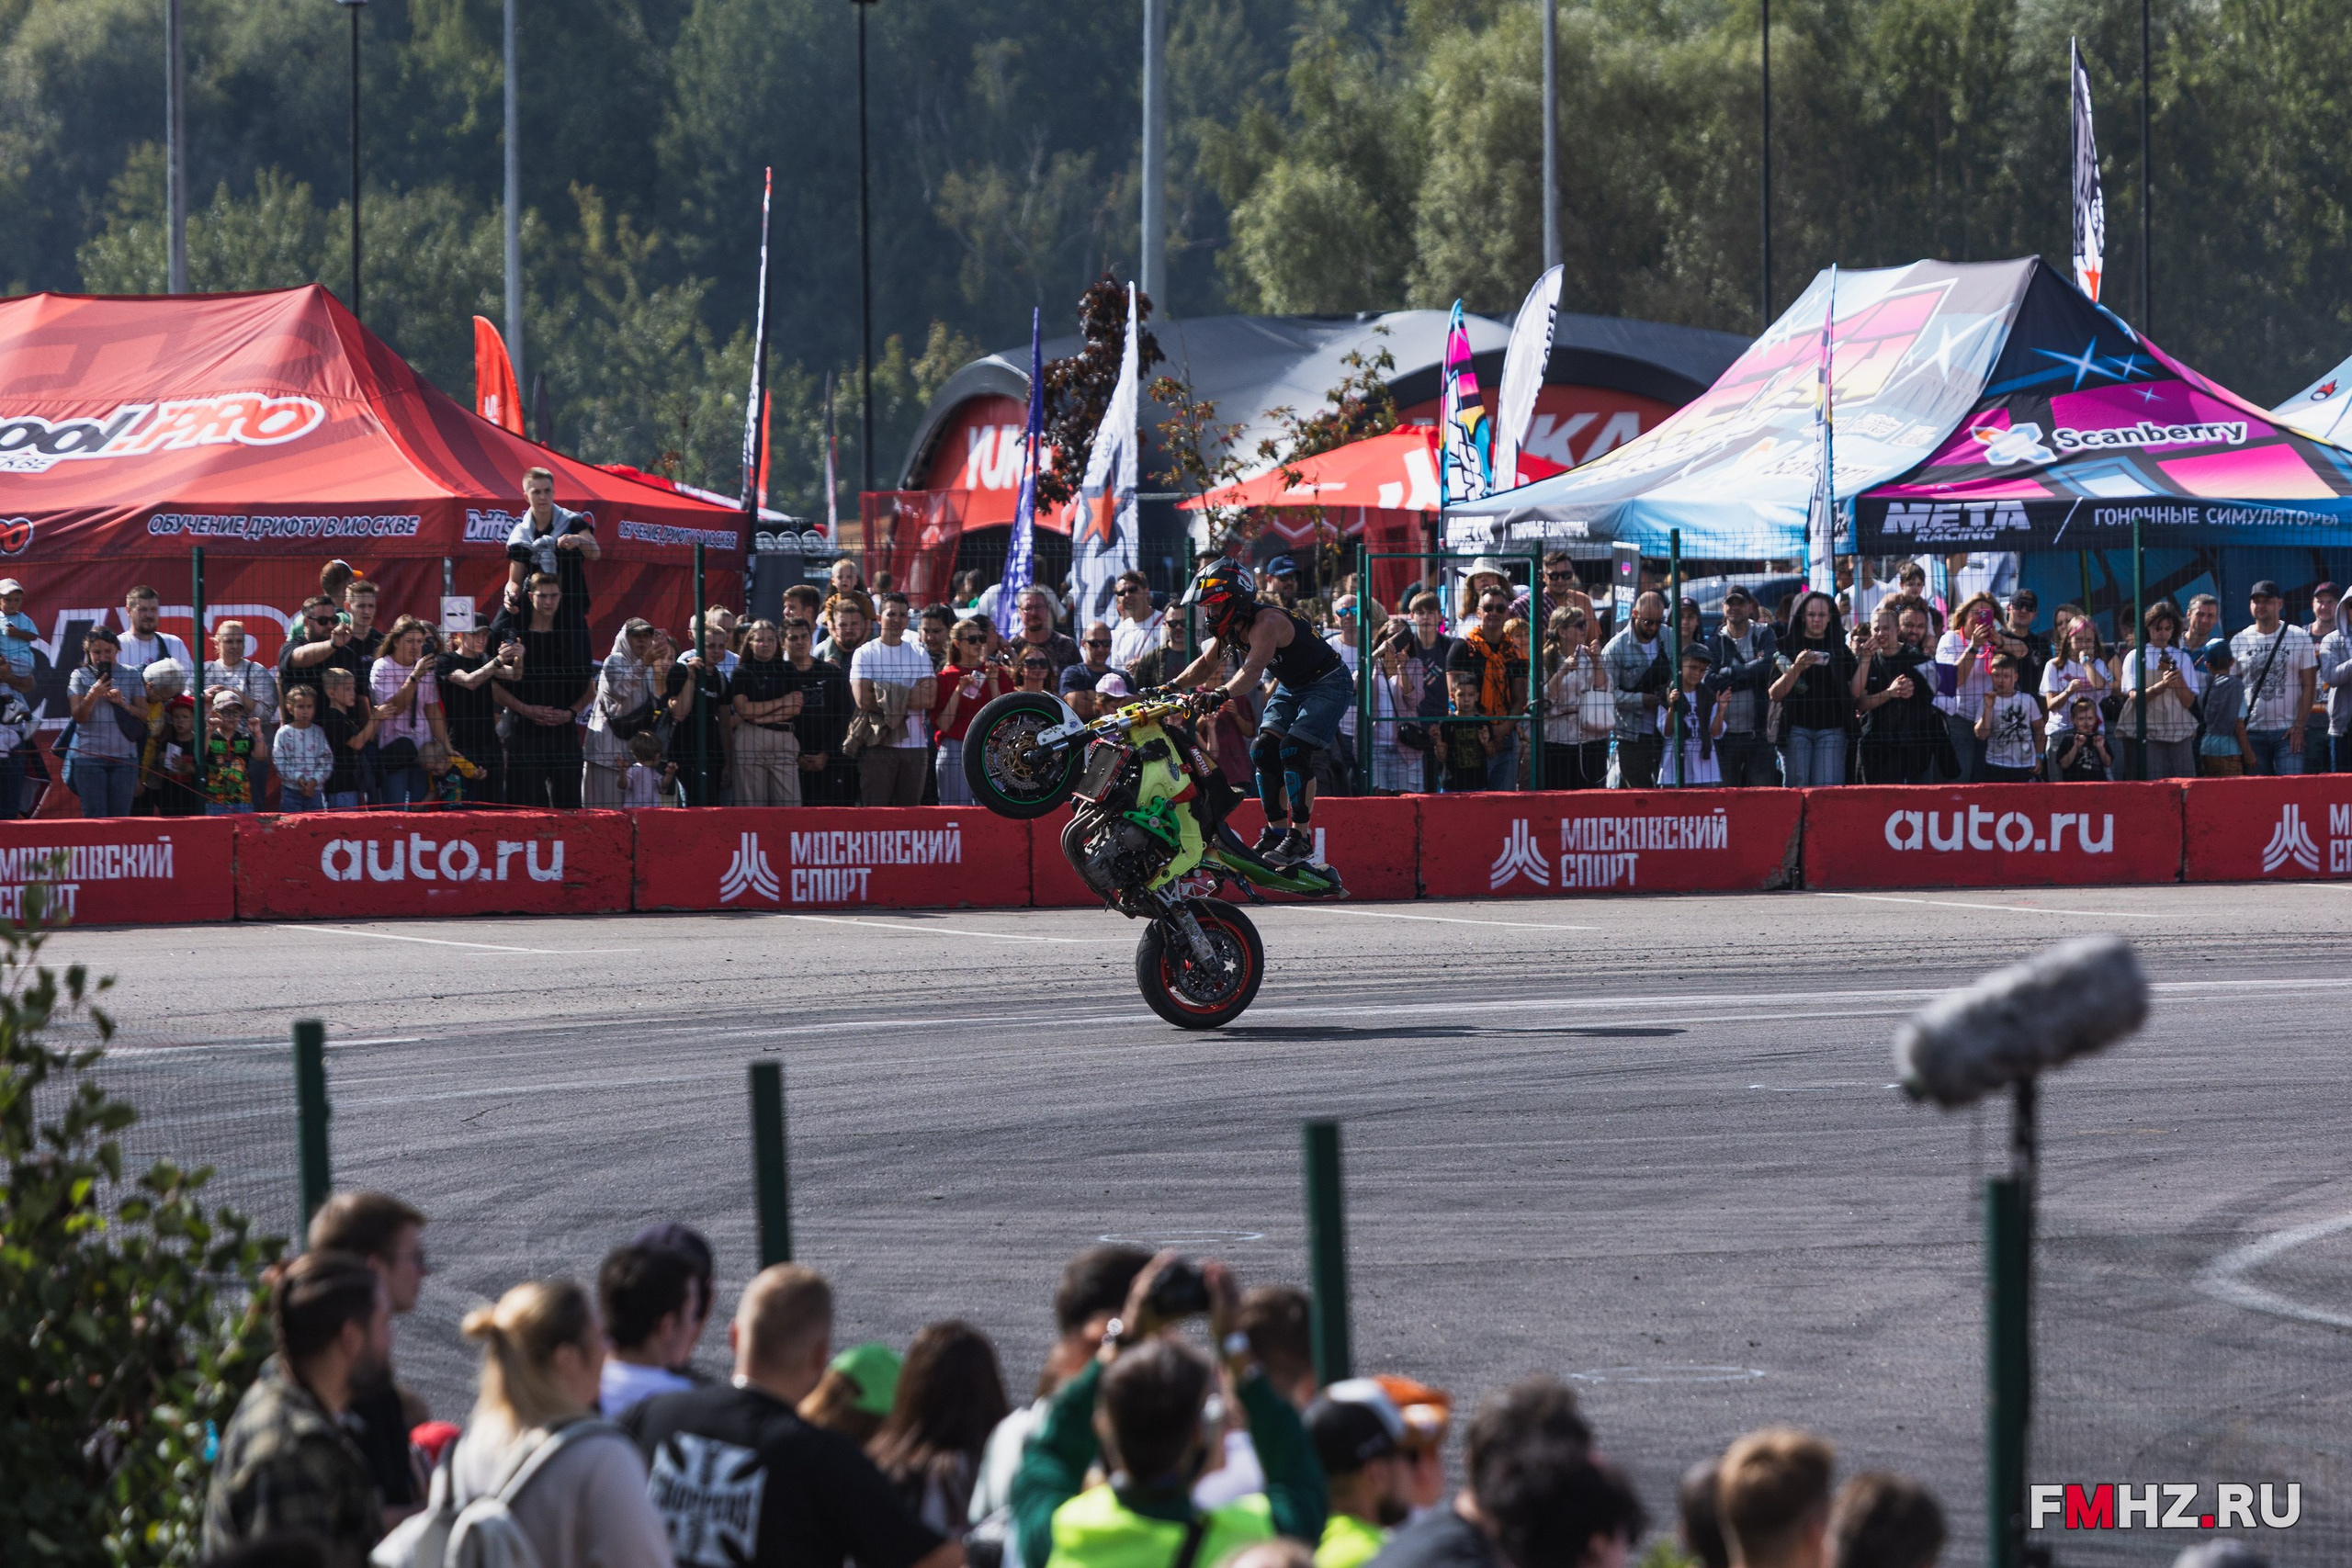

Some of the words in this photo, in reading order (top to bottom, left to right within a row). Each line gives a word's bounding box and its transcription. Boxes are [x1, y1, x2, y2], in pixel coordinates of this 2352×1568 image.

[2052, 422, 2247, 452] Scanberry
[148, 514, 247, 536] ОБУЧЕНИЕ
[243, 516, 328, 541] ДРИФТУ
[322, 516, 339, 536] В
[336, 515, 421, 536] МОСКВЕ
[1882, 501, 2032, 535] META
[2095, 506, 2199, 527] ГОНОЧНЫЕ
[1915, 526, 1999, 543] RACING
[1191, 747, 1212, 775] MOTUL
[790, 822, 962, 865] МОСКОВСКИЙ
[1561, 807, 1728, 851] МОСКОВСКИЙ
[1884, 805, 2114, 854] auto.ru
[321, 832, 564, 883] auto.ru
[1561, 852, 1639, 888] СПОРТ
[791, 868, 872, 903] СПОРТ
